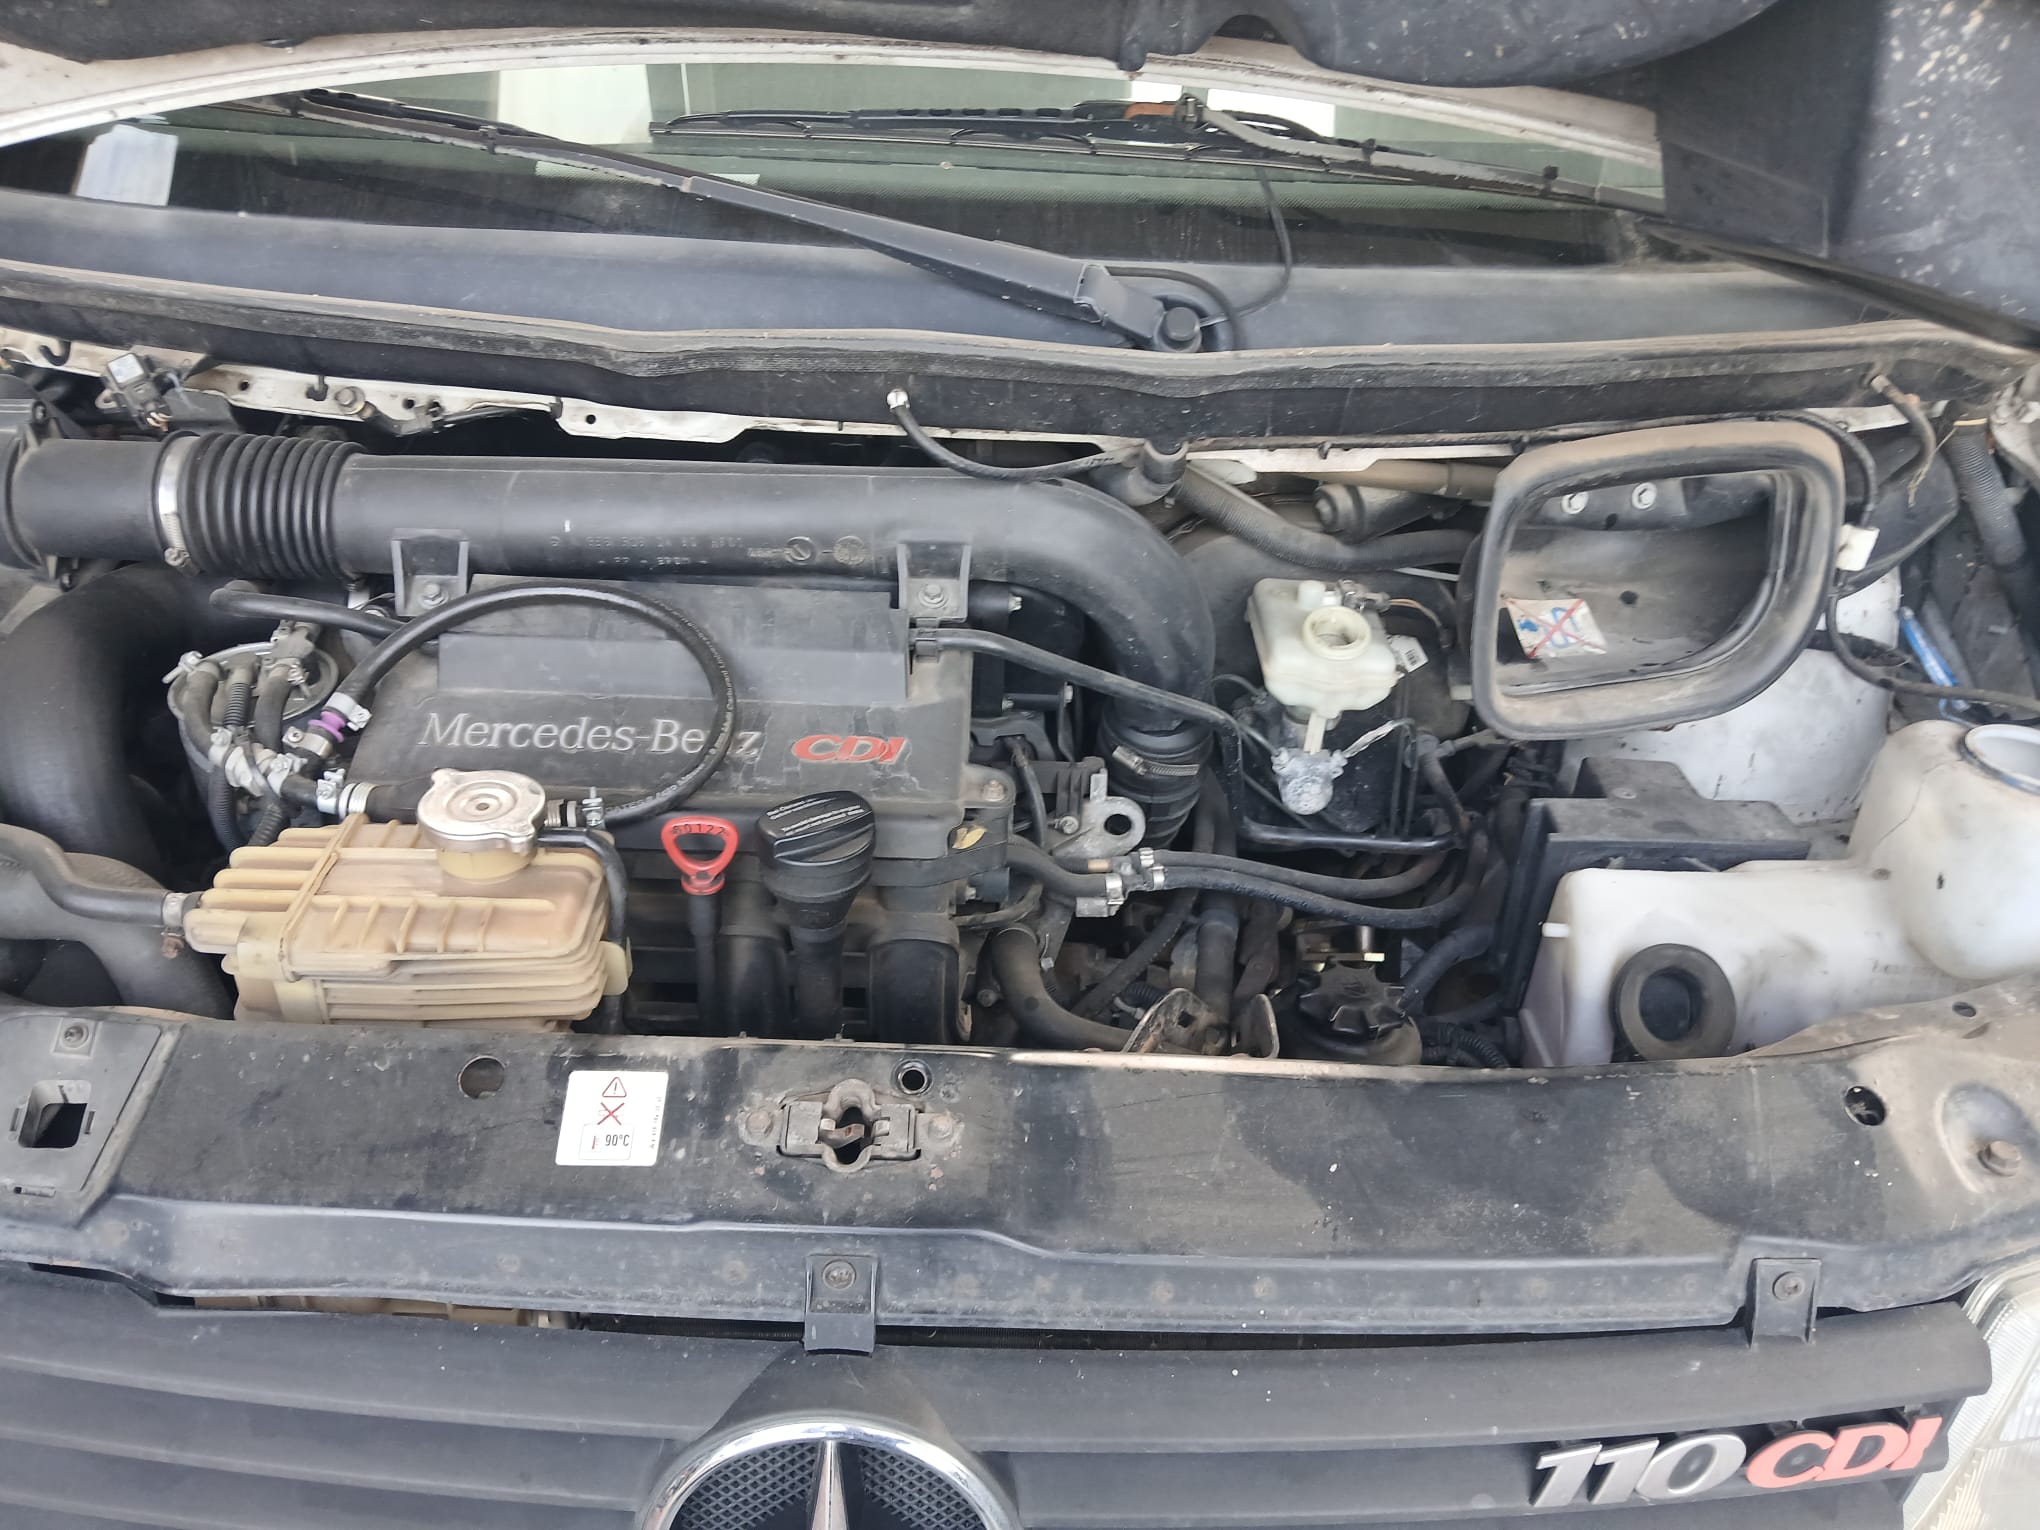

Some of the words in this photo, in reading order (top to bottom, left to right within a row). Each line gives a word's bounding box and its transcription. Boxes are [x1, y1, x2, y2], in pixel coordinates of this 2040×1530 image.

[416, 711, 762, 757] Mercedes-Bez
[791, 733, 908, 765] CDI
[605, 1134, 630, 1147] 90°C
[1529, 1433, 1747, 1508] 110
[1746, 1416, 1942, 1489] CDI
